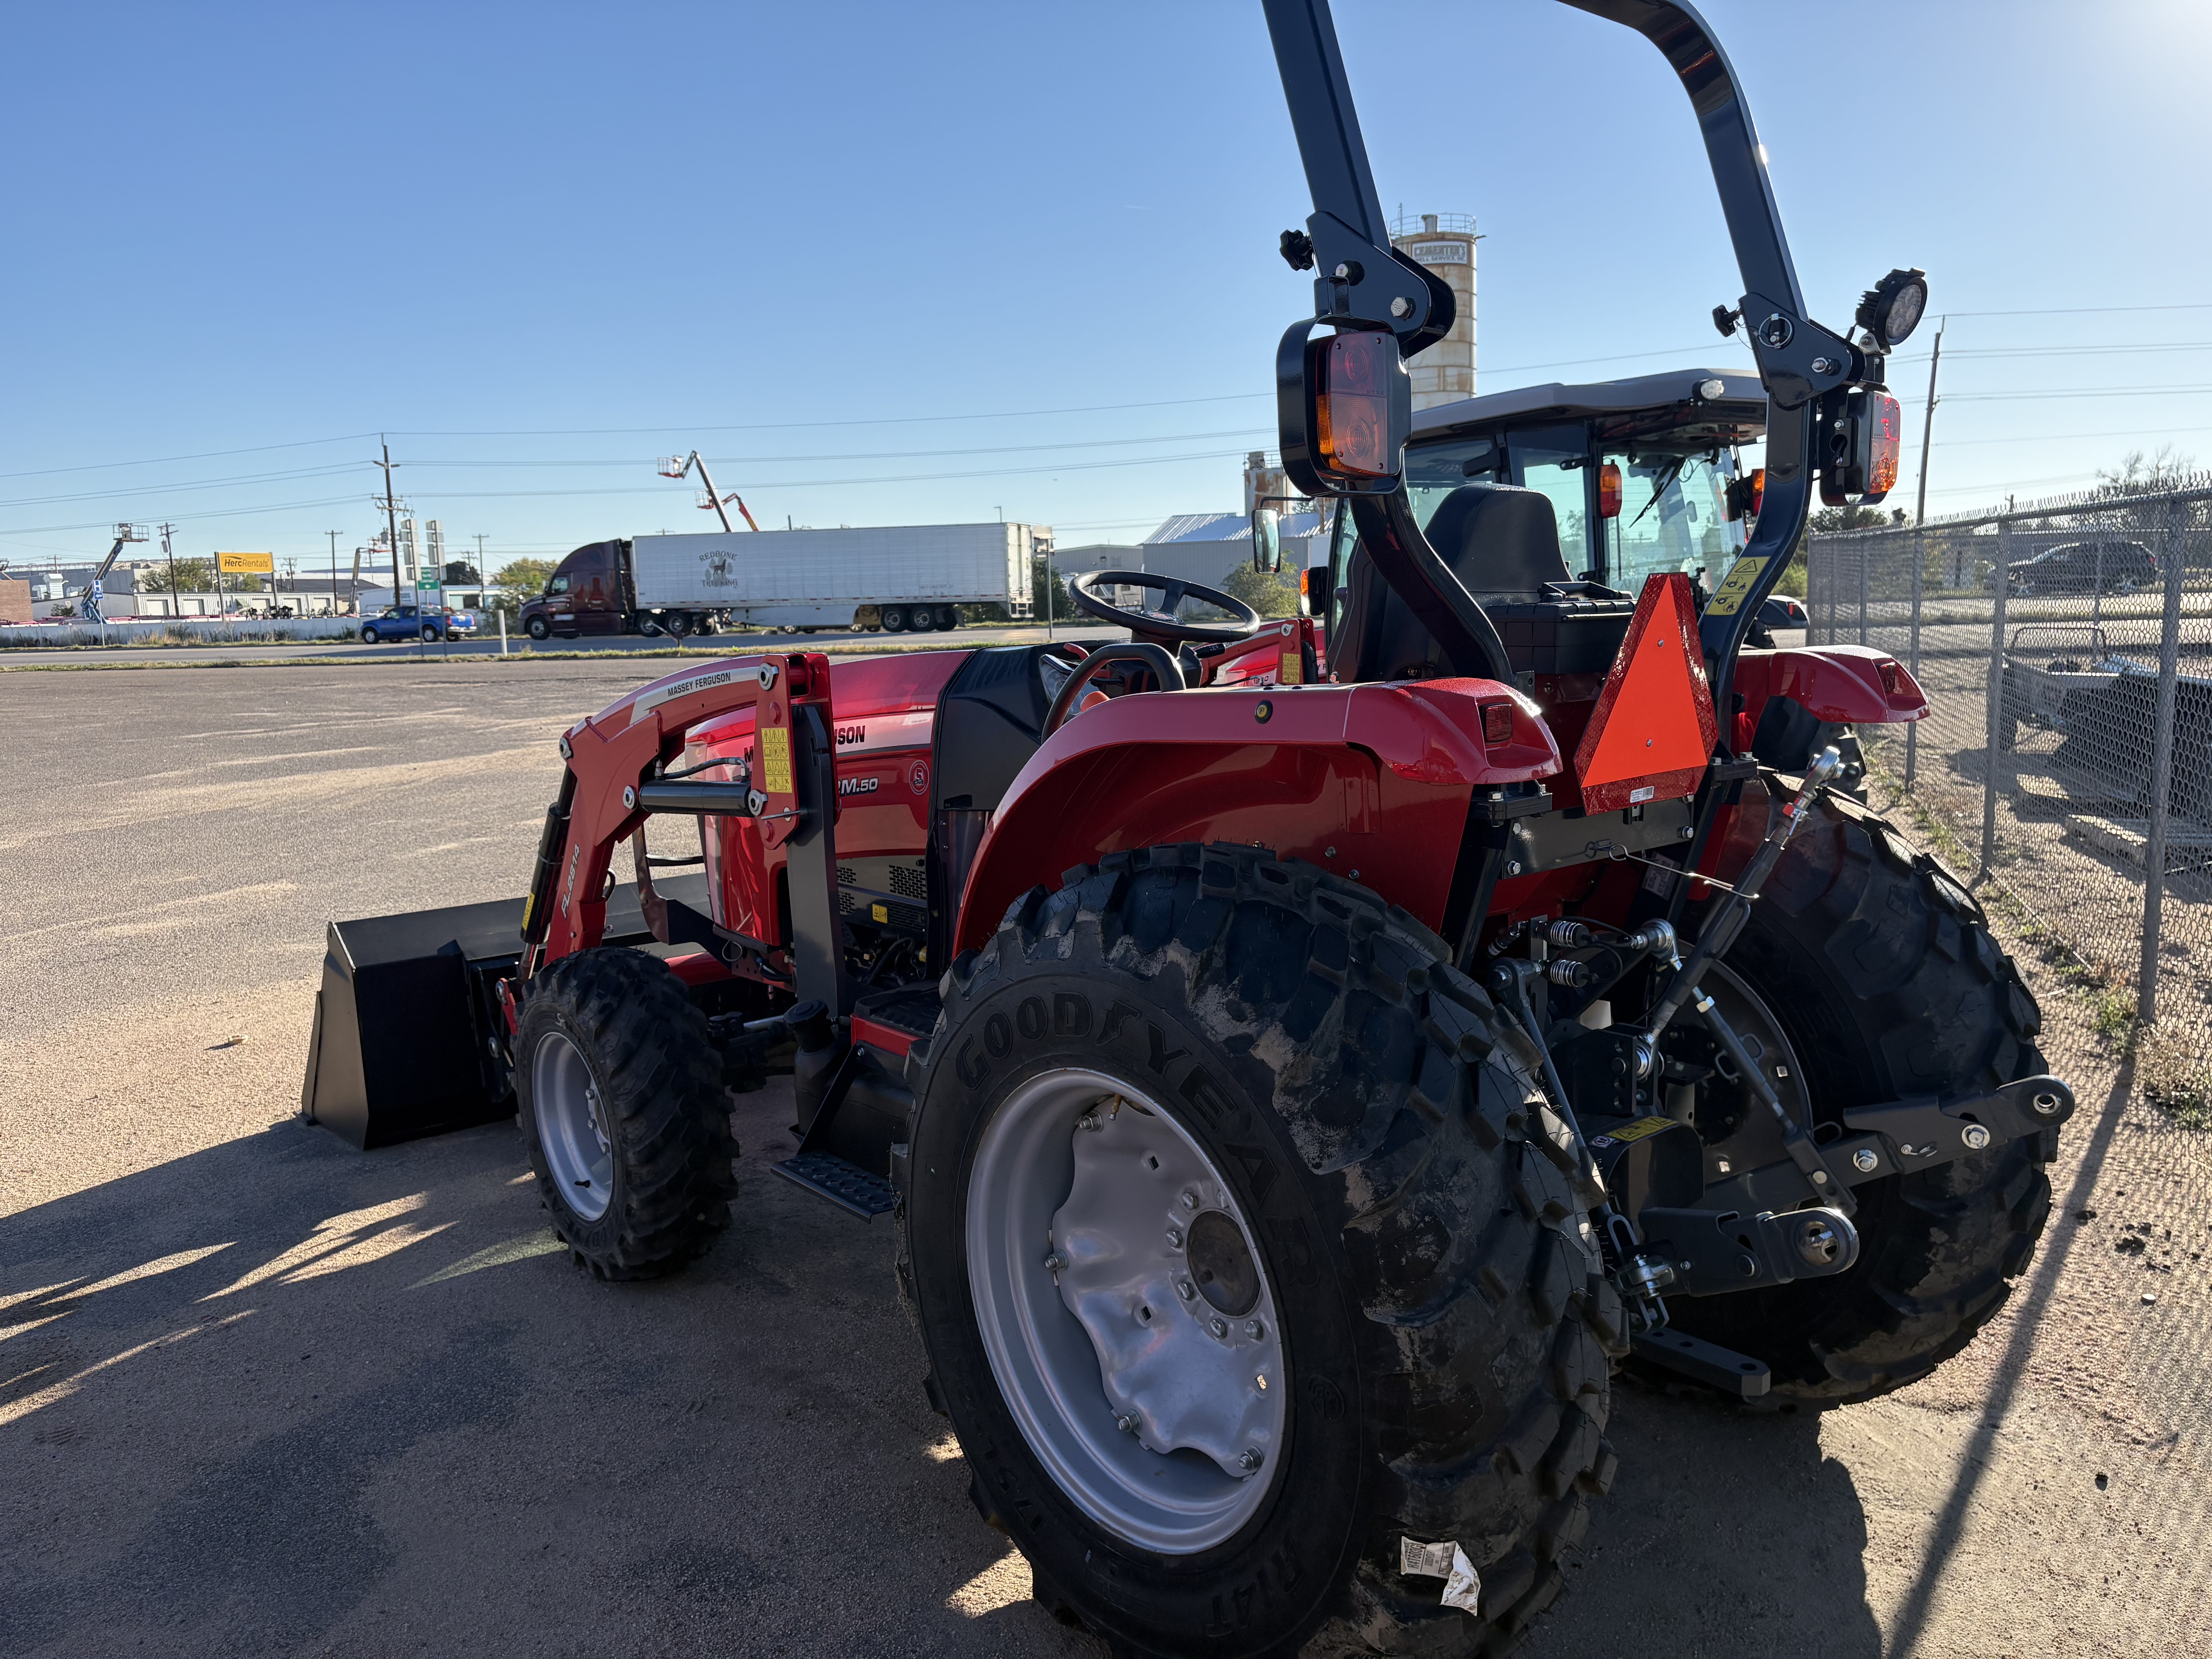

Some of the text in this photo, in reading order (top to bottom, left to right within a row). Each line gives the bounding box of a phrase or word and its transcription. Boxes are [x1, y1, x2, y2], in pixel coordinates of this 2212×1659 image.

[699, 550, 737, 562] REDBONE
[225, 558, 268, 567] HercRentals
[93, 580, 102, 592] H
[668, 672, 731, 697] MASSEY FERGUSON
[955, 991, 1321, 1288] GOODYEAR
